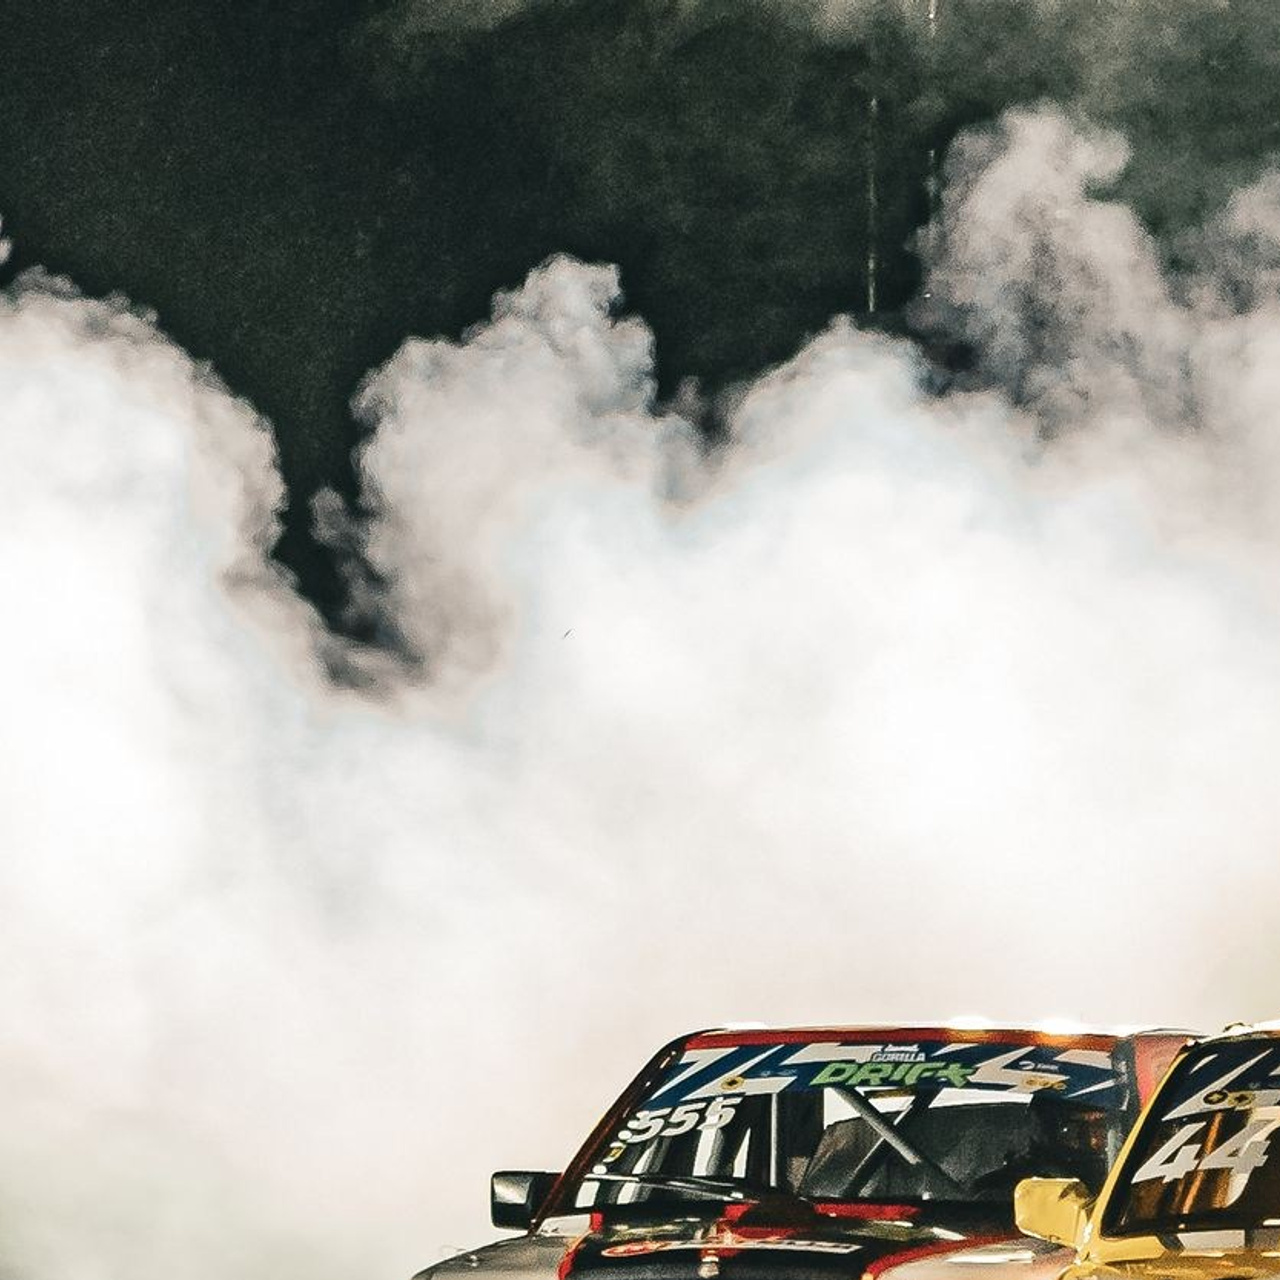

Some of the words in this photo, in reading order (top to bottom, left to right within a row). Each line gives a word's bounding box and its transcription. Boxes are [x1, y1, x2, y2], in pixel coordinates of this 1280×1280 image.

[871, 1052, 926, 1062] GORILLA
[626, 1096, 744, 1144] 555
[1131, 1118, 1274, 1185] 44
